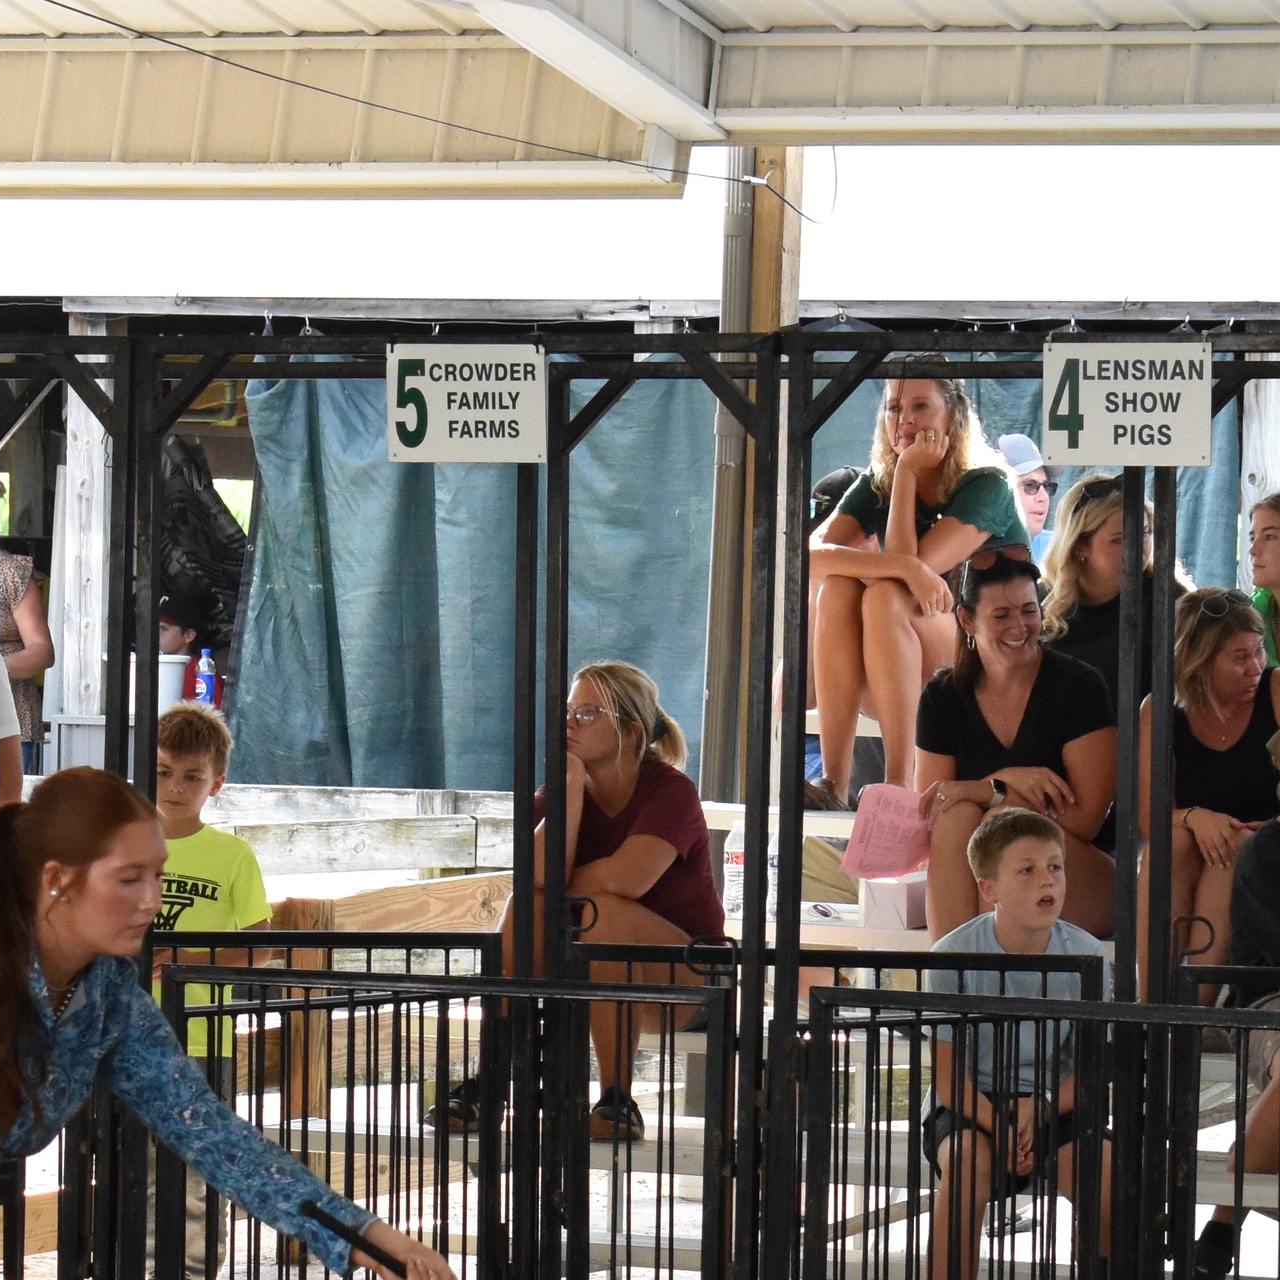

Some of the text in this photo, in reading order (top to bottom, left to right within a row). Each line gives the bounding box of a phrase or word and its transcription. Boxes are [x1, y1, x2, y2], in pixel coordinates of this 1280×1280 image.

[429, 362, 536, 382] CROWDER
[1082, 358, 1204, 381] LENSMAN
[395, 358, 428, 449] 5
[446, 391, 521, 410] FAMILY
[1048, 358, 1084, 449] 4
[1105, 391, 1182, 413] SHOW
[448, 419, 520, 439] FARMS
[1113, 424, 1172, 446] PIGS
[161, 878, 218, 901] TBALL
